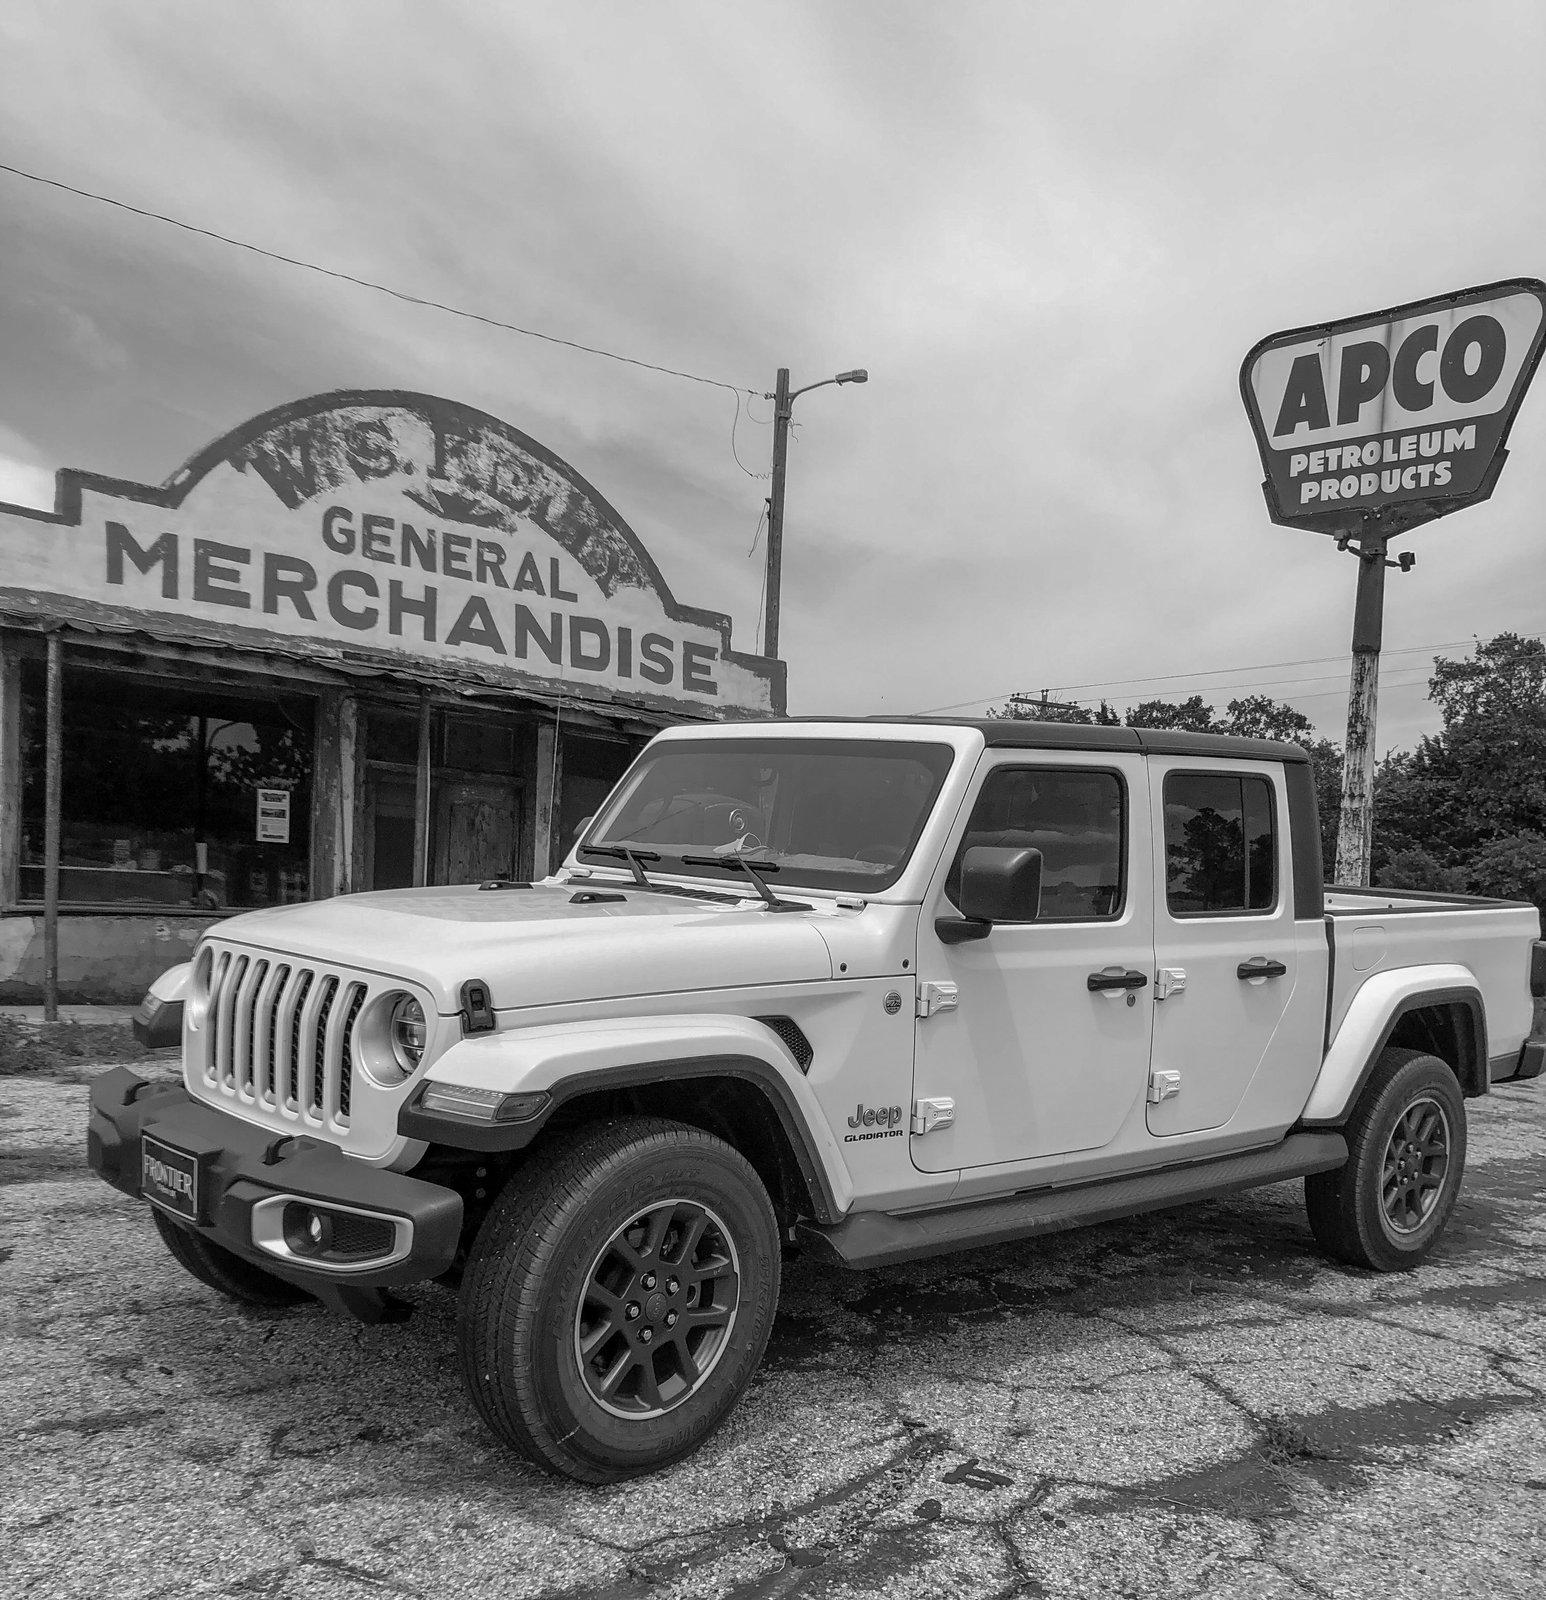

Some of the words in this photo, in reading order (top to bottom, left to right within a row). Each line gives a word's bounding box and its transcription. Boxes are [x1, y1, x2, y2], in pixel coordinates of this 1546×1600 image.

[1273, 314, 1507, 438] APCO
[1289, 424, 1477, 478] PETROLEUM
[1300, 460, 1453, 505] PRODUCTS
[322, 505, 578, 602] GENERAL
[105, 521, 718, 695] MERCHANDISE
[844, 1130, 903, 1142] GLADIATOR
[847, 1103, 903, 1129] Jeep
